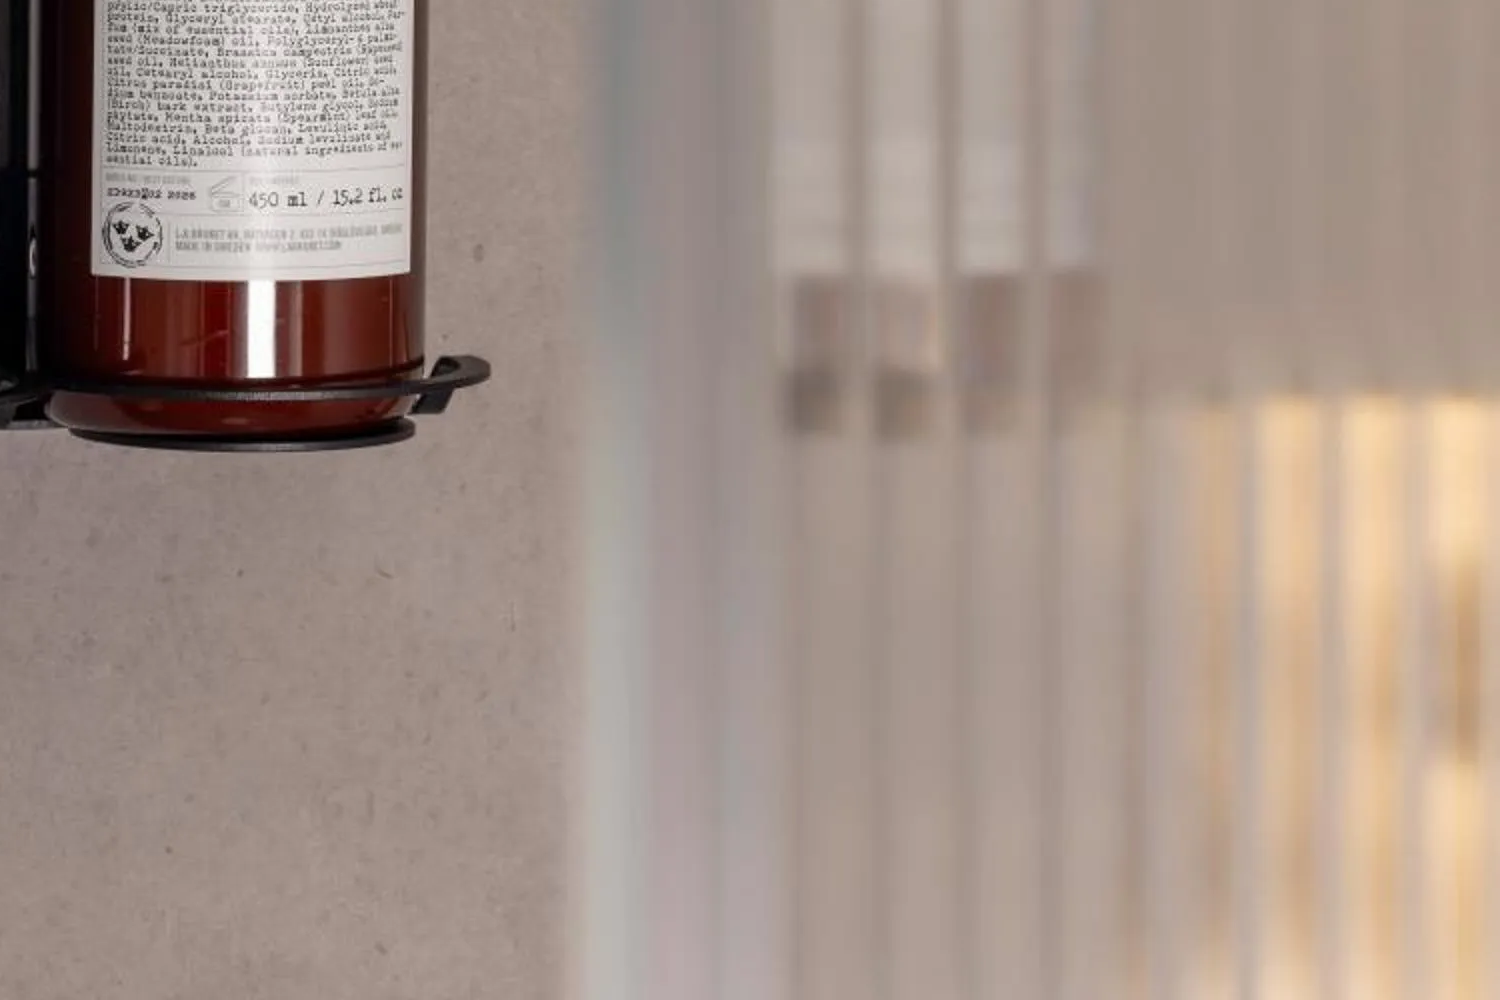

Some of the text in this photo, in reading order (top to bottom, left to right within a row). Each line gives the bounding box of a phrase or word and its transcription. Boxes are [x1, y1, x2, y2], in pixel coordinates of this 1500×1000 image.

[249, 192, 278, 208] 450
[287, 191, 306, 207] ml
[332, 189, 363, 206] 15.2
